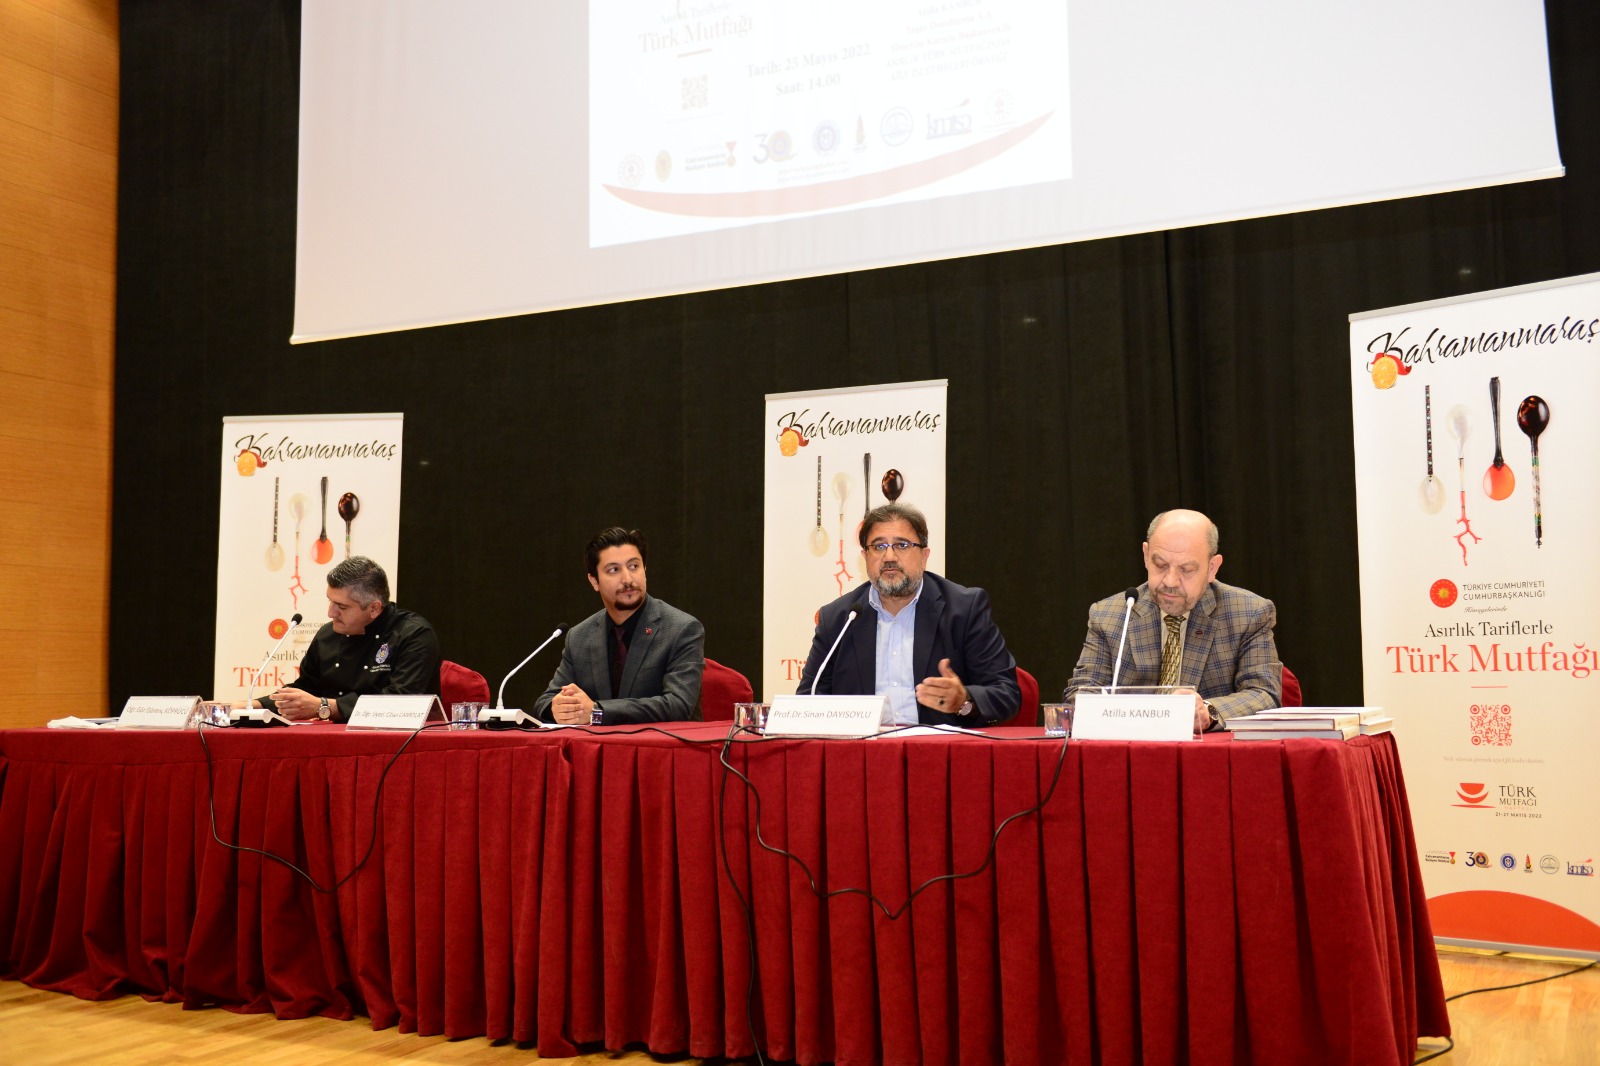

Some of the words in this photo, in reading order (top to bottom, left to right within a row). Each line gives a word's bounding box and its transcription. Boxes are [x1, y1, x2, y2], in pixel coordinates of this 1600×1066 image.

[638, 27, 679, 52] Türk
[684, 14, 753, 44] Mutfağı
[745, 60, 782, 78] Tarih:
[784, 56, 800, 71] 25
[803, 52, 839, 68] Mayıs
[841, 43, 872, 60] 2022
[775, 82, 805, 97] Saat:
[808, 73, 842, 90] 14.00
[1462, 582, 1492, 591] TÜRKİYE
[1493, 580, 1545, 590] CUMHURİYETİ
[1463, 590, 1546, 601] CUMHURBAŞKANLIĞI
[1424, 622, 1476, 638] Asırlık
[1478, 619, 1553, 637] Tariflerle
[1386, 644, 1461, 674] Türk
[1467, 641, 1600, 678] Mutfağı
[826, 711, 872, 719] DAYISOYLU
[1102, 709, 1126, 719] Atilla
[1129, 709, 1171, 719] KANBUR
[1498, 784, 1537, 798] TÜRK
[1499, 798, 1537, 806] MUTFAĞI
